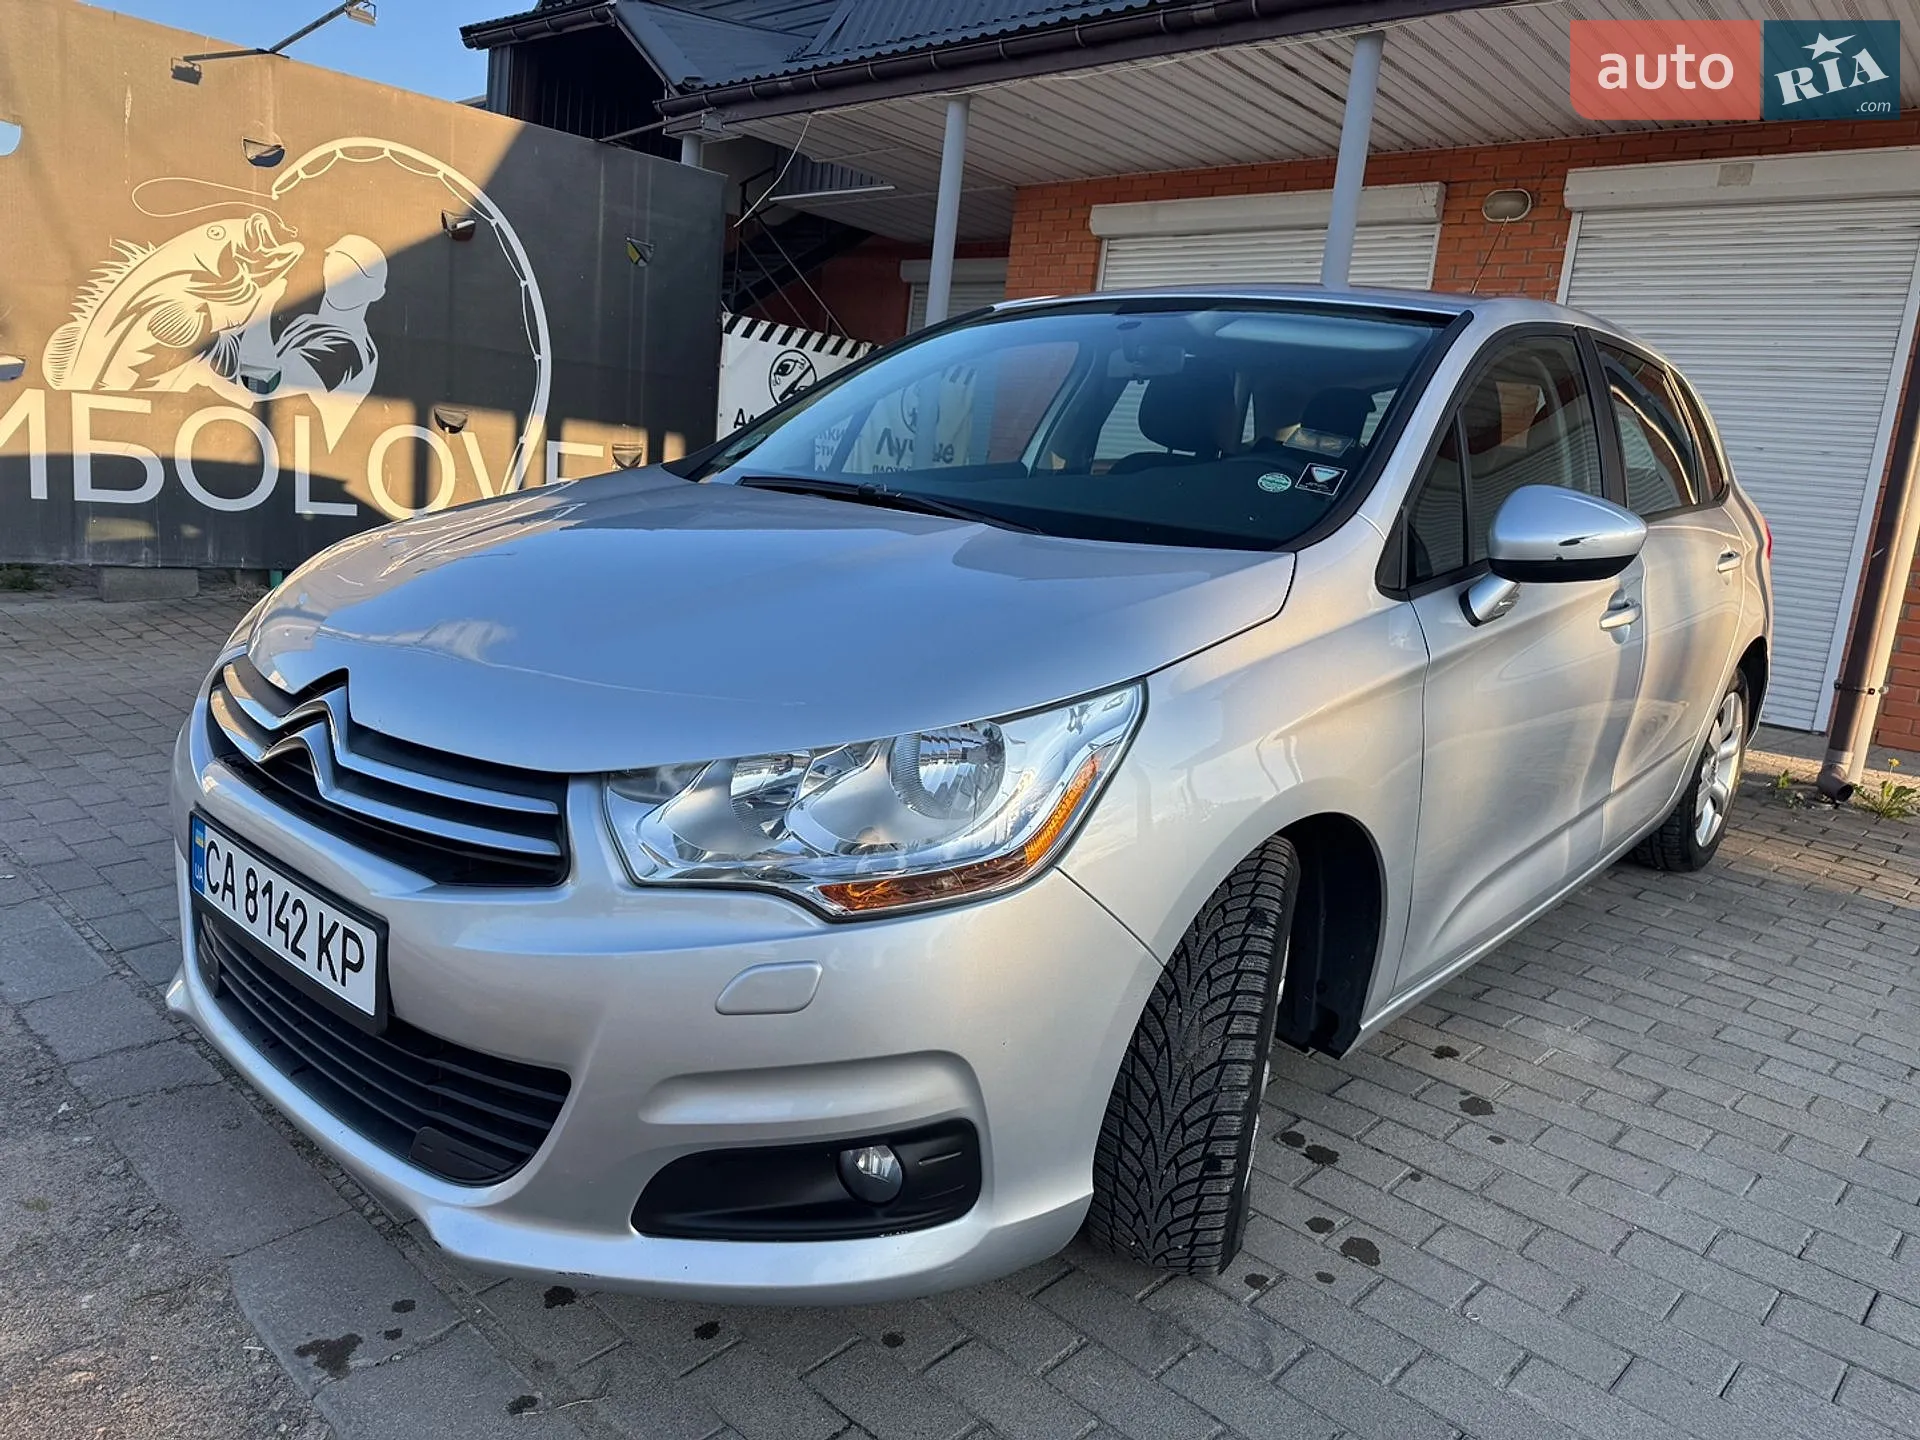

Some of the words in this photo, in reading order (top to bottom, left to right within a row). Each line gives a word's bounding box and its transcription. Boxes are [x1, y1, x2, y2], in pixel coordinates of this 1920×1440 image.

[194, 862, 204, 883] UA
[205, 838, 237, 911] CA
[244, 867, 308, 963] 8142
[317, 911, 366, 987] KP
